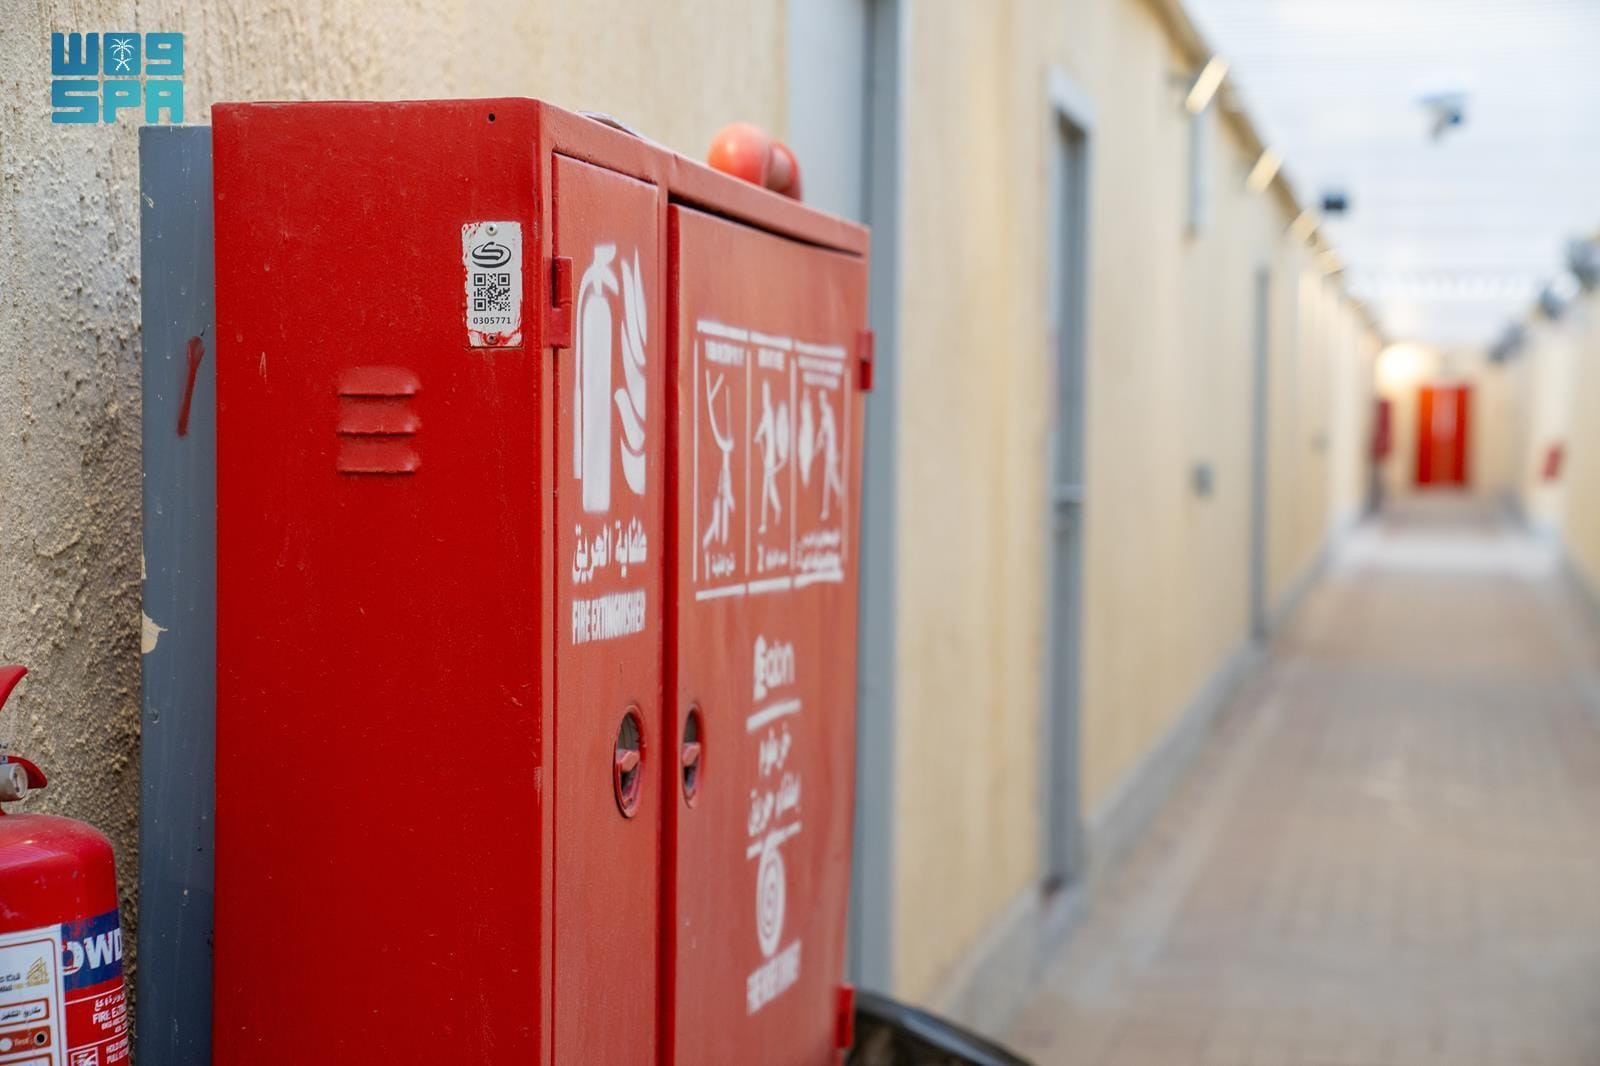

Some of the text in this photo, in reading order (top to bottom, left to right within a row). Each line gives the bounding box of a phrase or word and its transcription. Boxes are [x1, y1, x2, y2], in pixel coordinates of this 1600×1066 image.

[473, 317, 511, 325] 0305771
[572, 599, 591, 645] FIRE
[93, 1010, 111, 1024] FIRE
